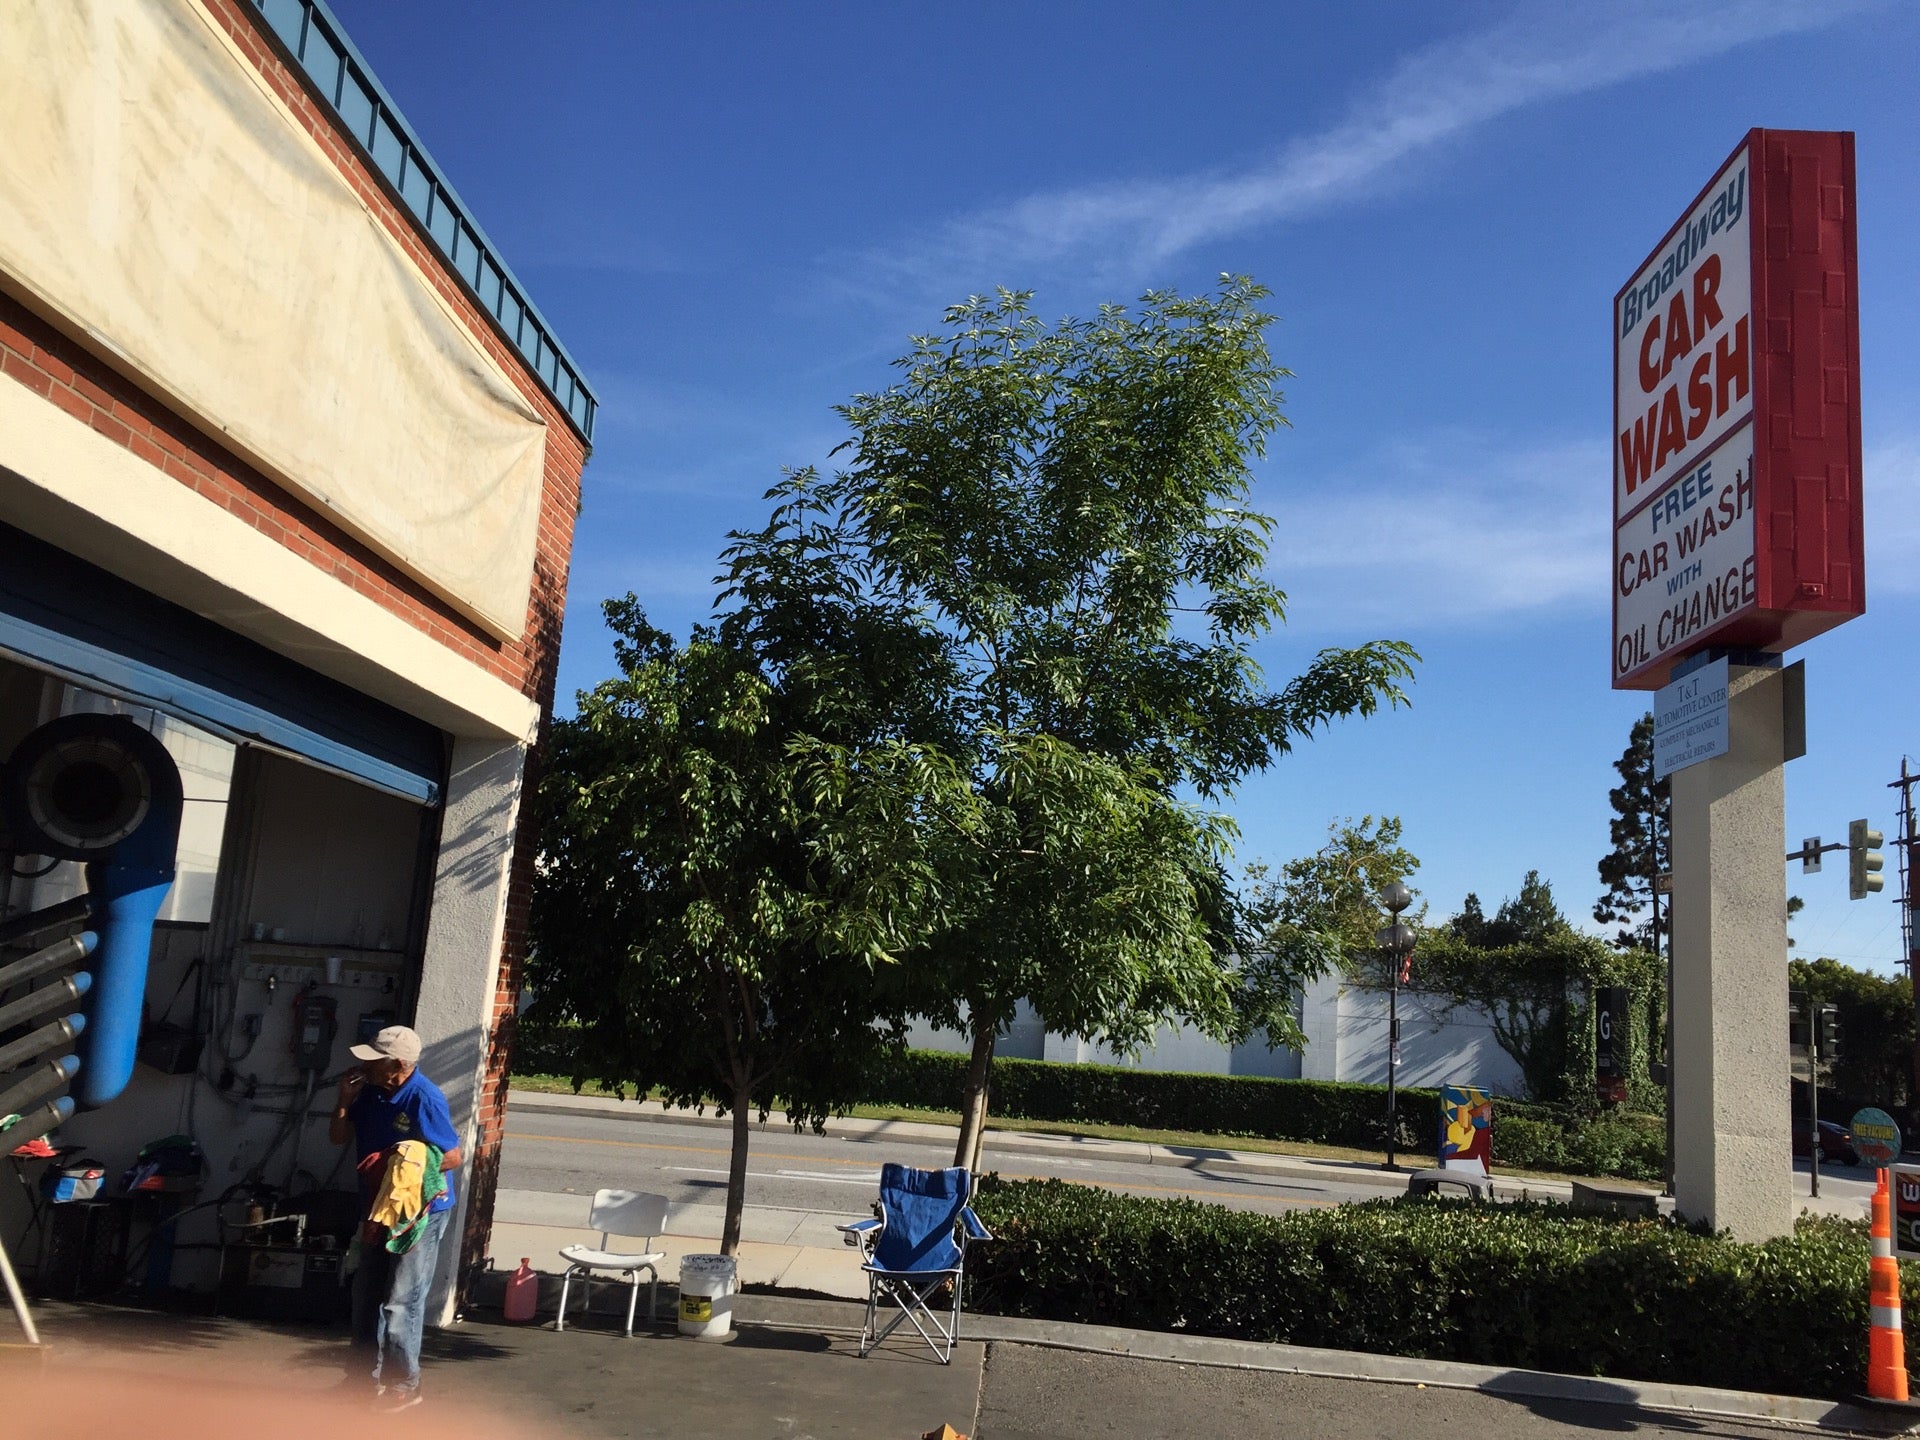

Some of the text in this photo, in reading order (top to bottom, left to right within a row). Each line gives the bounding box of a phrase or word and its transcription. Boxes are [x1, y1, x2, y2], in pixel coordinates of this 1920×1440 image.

[1621, 166, 1746, 340] Broadway
[1638, 253, 1724, 394] CAR
[1620, 312, 1750, 496] WASH
[1619, 453, 1754, 597] CAR WASH
[1651, 460, 1714, 535] FREE
[1618, 554, 1756, 674] OIL CHANGE
[1666, 559, 1702, 596] WITH
[1655, 687, 1727, 729] AUTOMOTIVE CENTER
